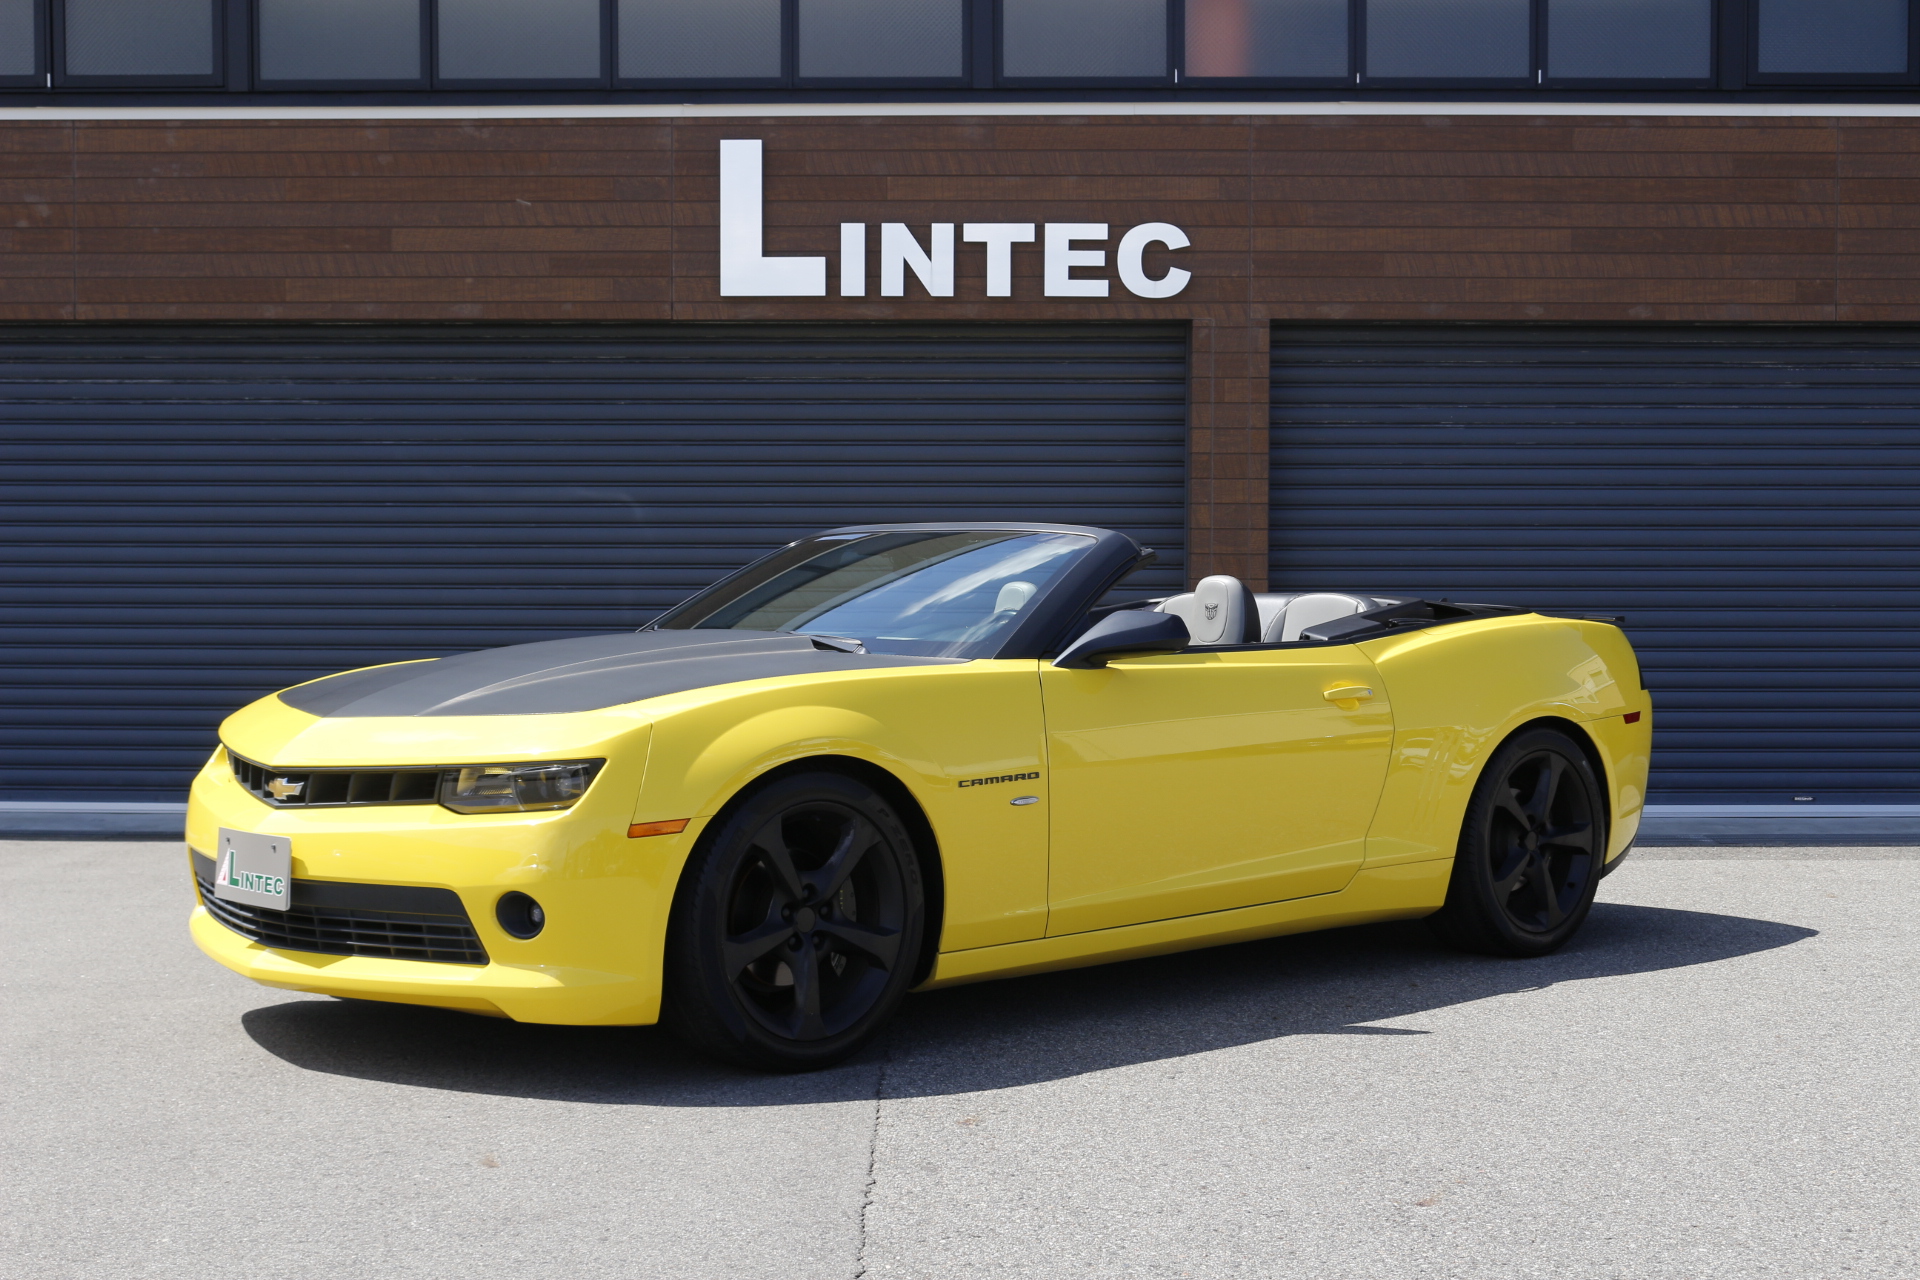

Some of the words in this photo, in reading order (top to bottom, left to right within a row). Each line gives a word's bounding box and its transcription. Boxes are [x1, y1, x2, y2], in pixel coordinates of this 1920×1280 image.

[720, 139, 1191, 298] LINTEC
[958, 771, 1040, 788] CAMARO
[229, 850, 284, 896] LINTEC
